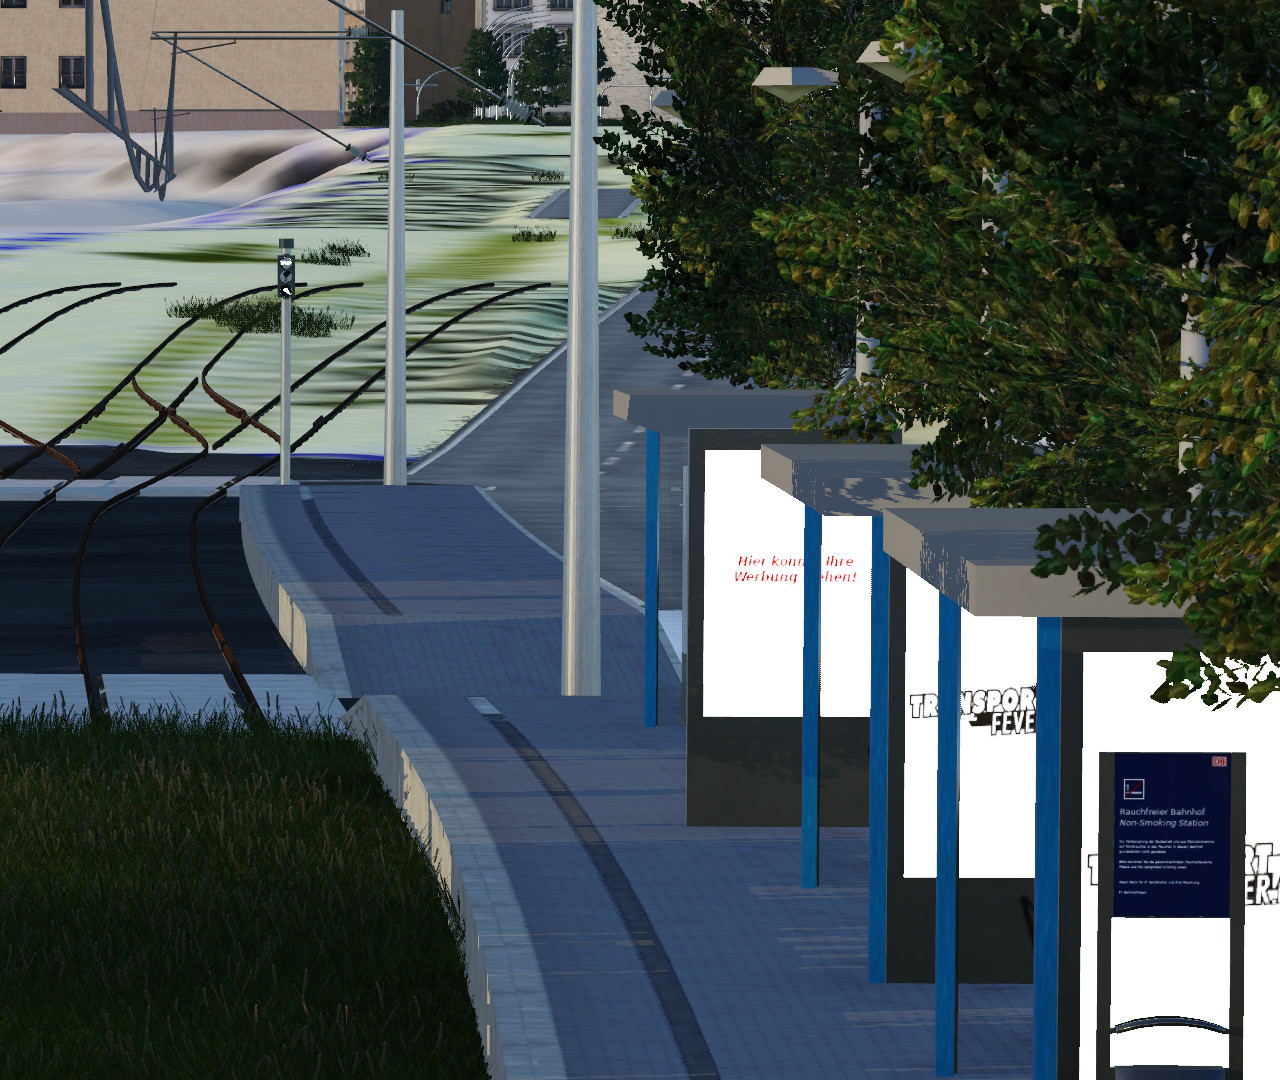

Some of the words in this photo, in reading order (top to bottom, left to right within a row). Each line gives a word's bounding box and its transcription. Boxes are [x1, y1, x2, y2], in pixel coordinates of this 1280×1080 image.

[739, 556, 765, 566] Hier
[826, 556, 853, 566] Ihre
[735, 571, 797, 583] Werbung
[910, 687, 1037, 719] TRNSPOR
[991, 711, 1037, 736] FEVE
[1119, 807, 1169, 816] Rauchfreier
[1170, 807, 1206, 816] Bahnhof
[1119, 818, 1177, 828] Non-Smoking
[1178, 818, 1209, 827] Station
